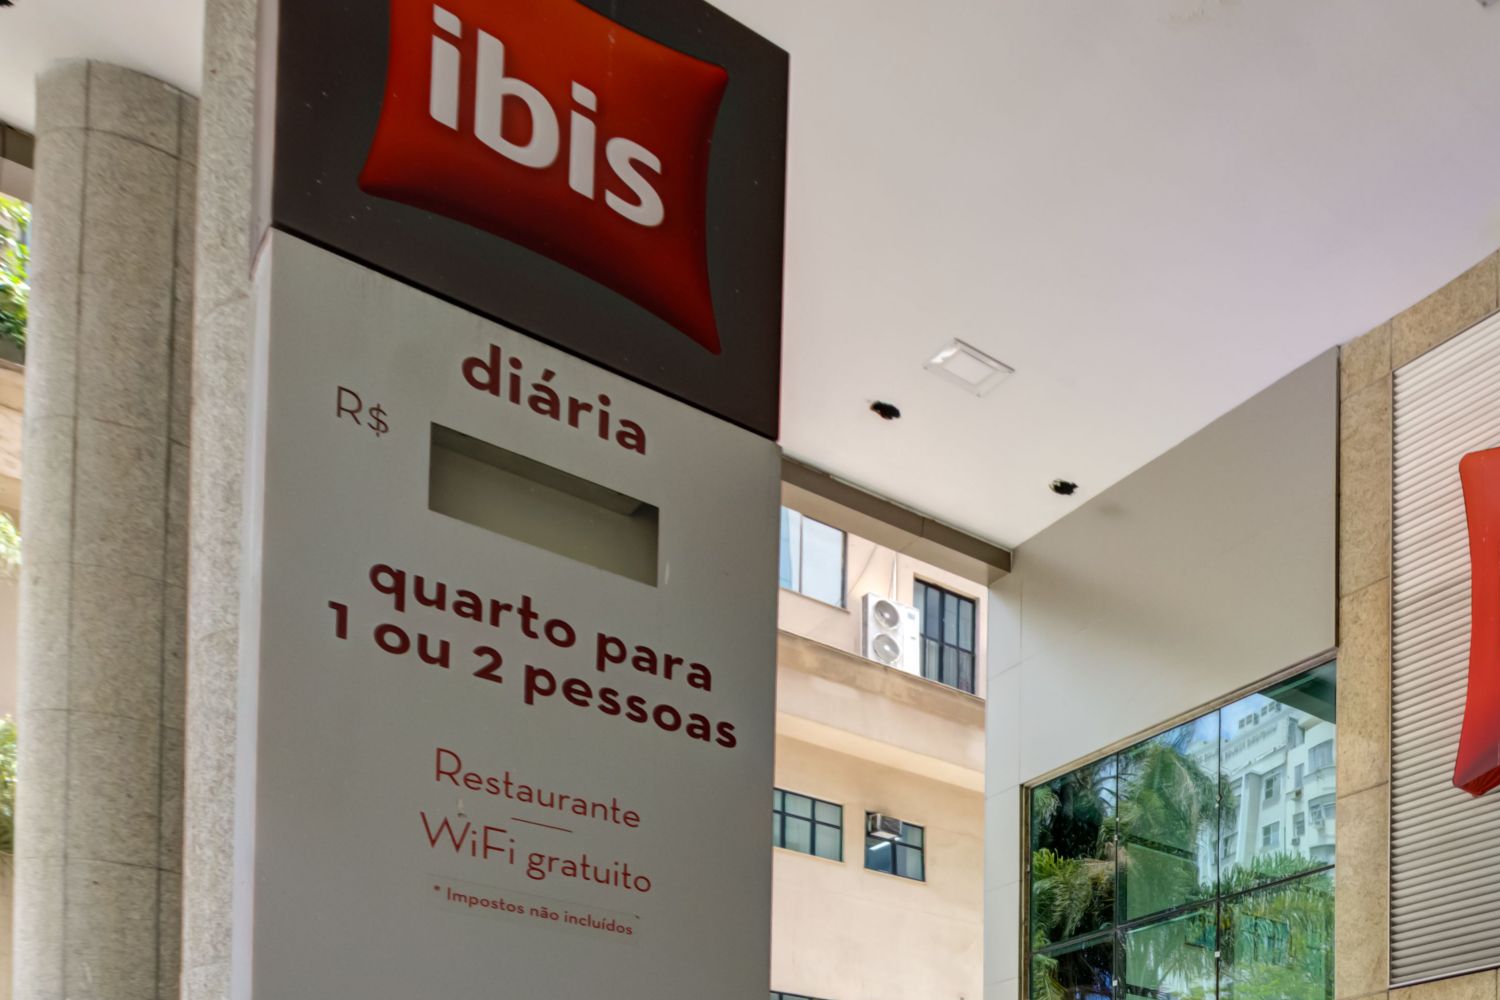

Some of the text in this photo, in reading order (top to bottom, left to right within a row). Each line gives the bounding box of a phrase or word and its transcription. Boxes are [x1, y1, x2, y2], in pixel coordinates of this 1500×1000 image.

[429, 3, 665, 227] ibis
[335, 385, 390, 438] R$
[462, 344, 647, 455] diária
[328, 600, 737, 749] 1 ou 2 pessoas
[369, 563, 713, 692] quarto para
[435, 747, 641, 828] Restaurante
[420, 811, 652, 893] WiFi gratuito
[447, 887, 633, 936] Impostos não incluídos
